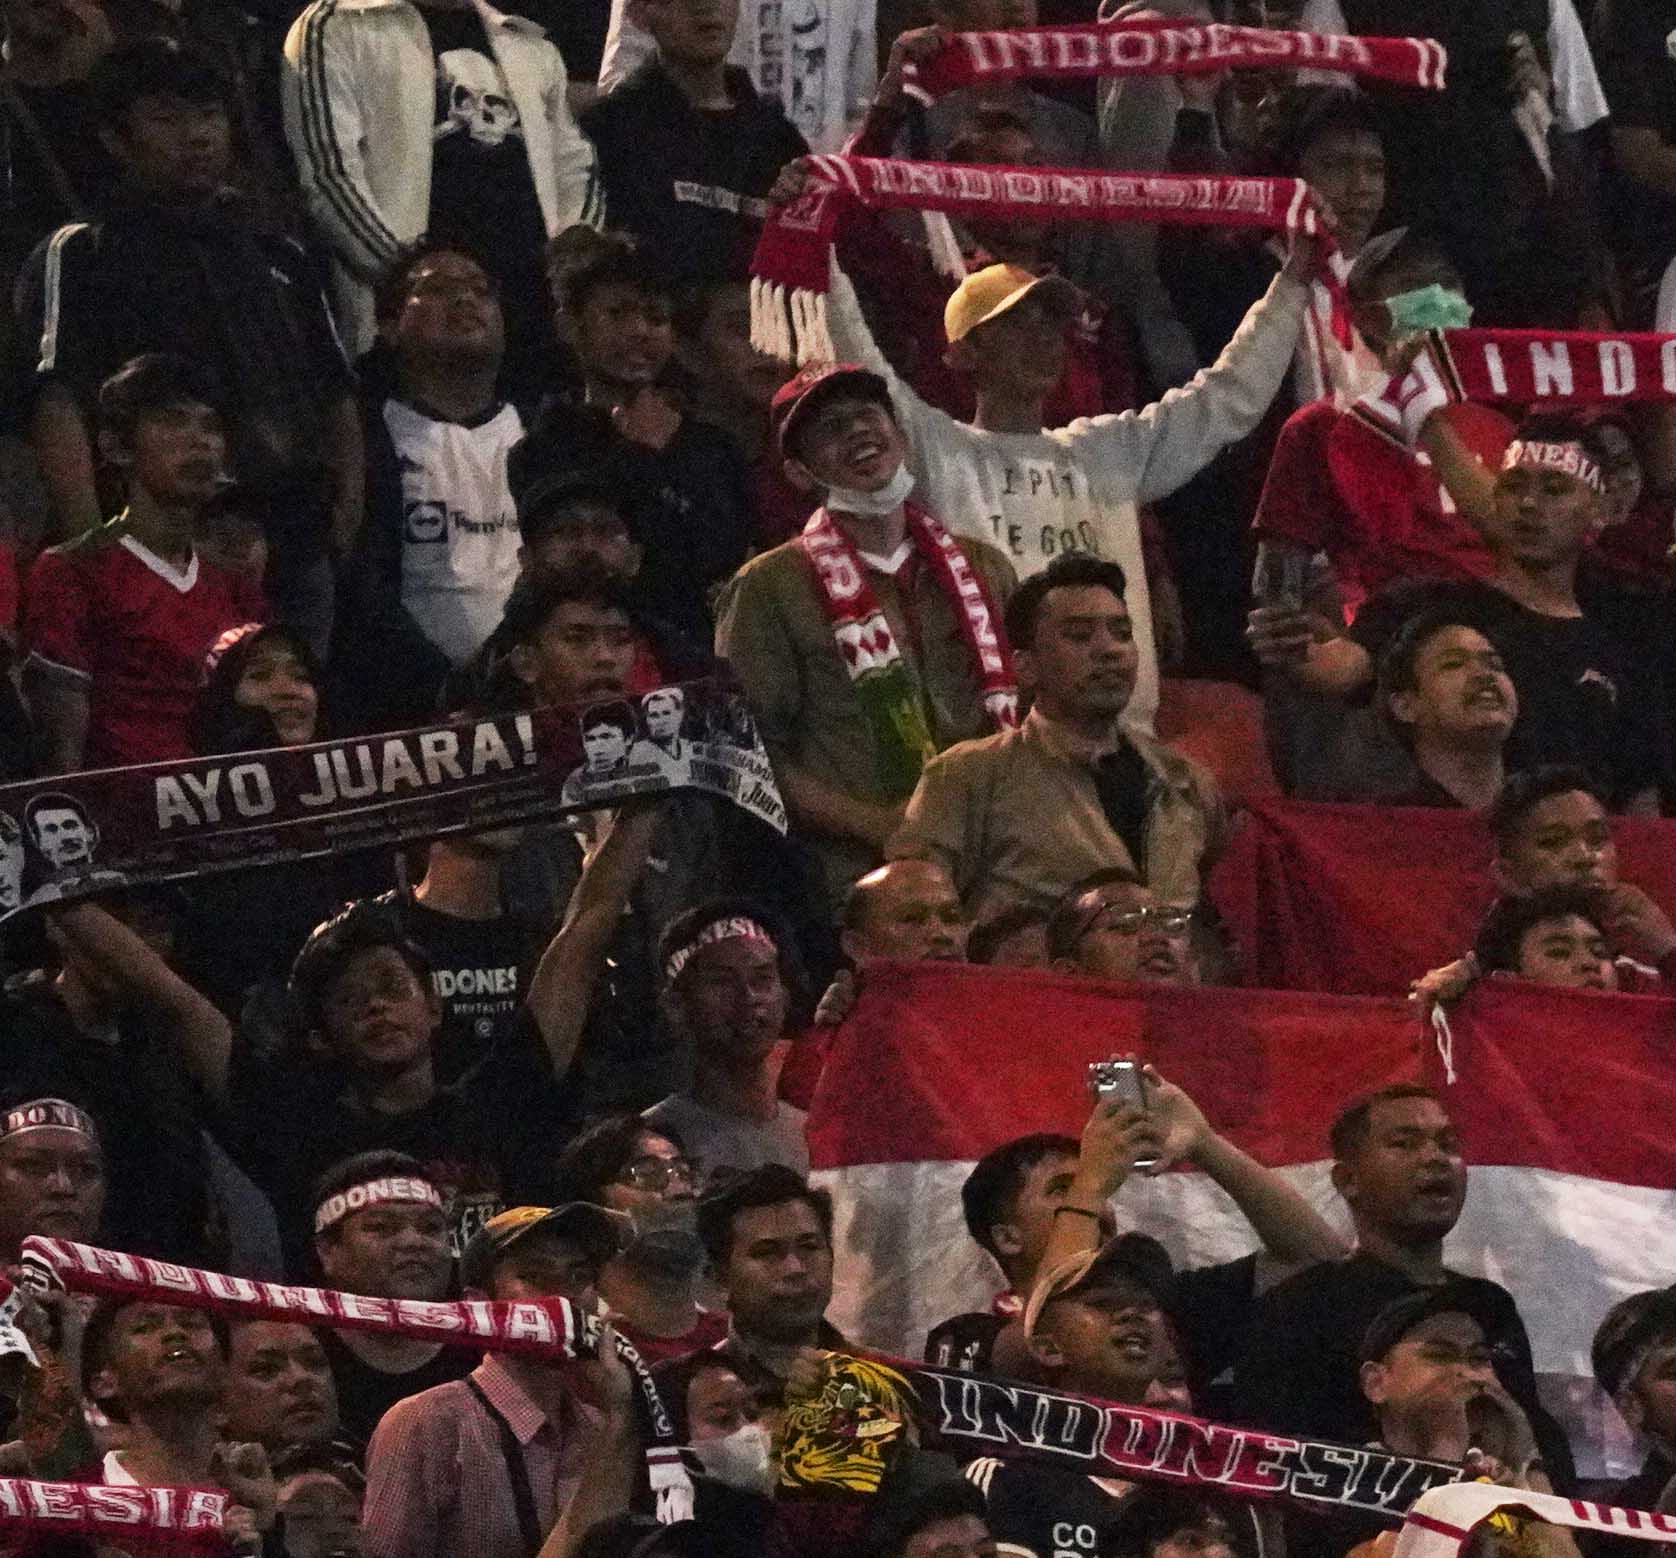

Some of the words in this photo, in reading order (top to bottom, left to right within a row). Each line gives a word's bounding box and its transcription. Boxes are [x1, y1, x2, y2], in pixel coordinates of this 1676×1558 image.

[962, 25, 1371, 72] INDONESIA
[154, 761, 276, 831] AYO
[299, 714, 538, 807] JUARA!
